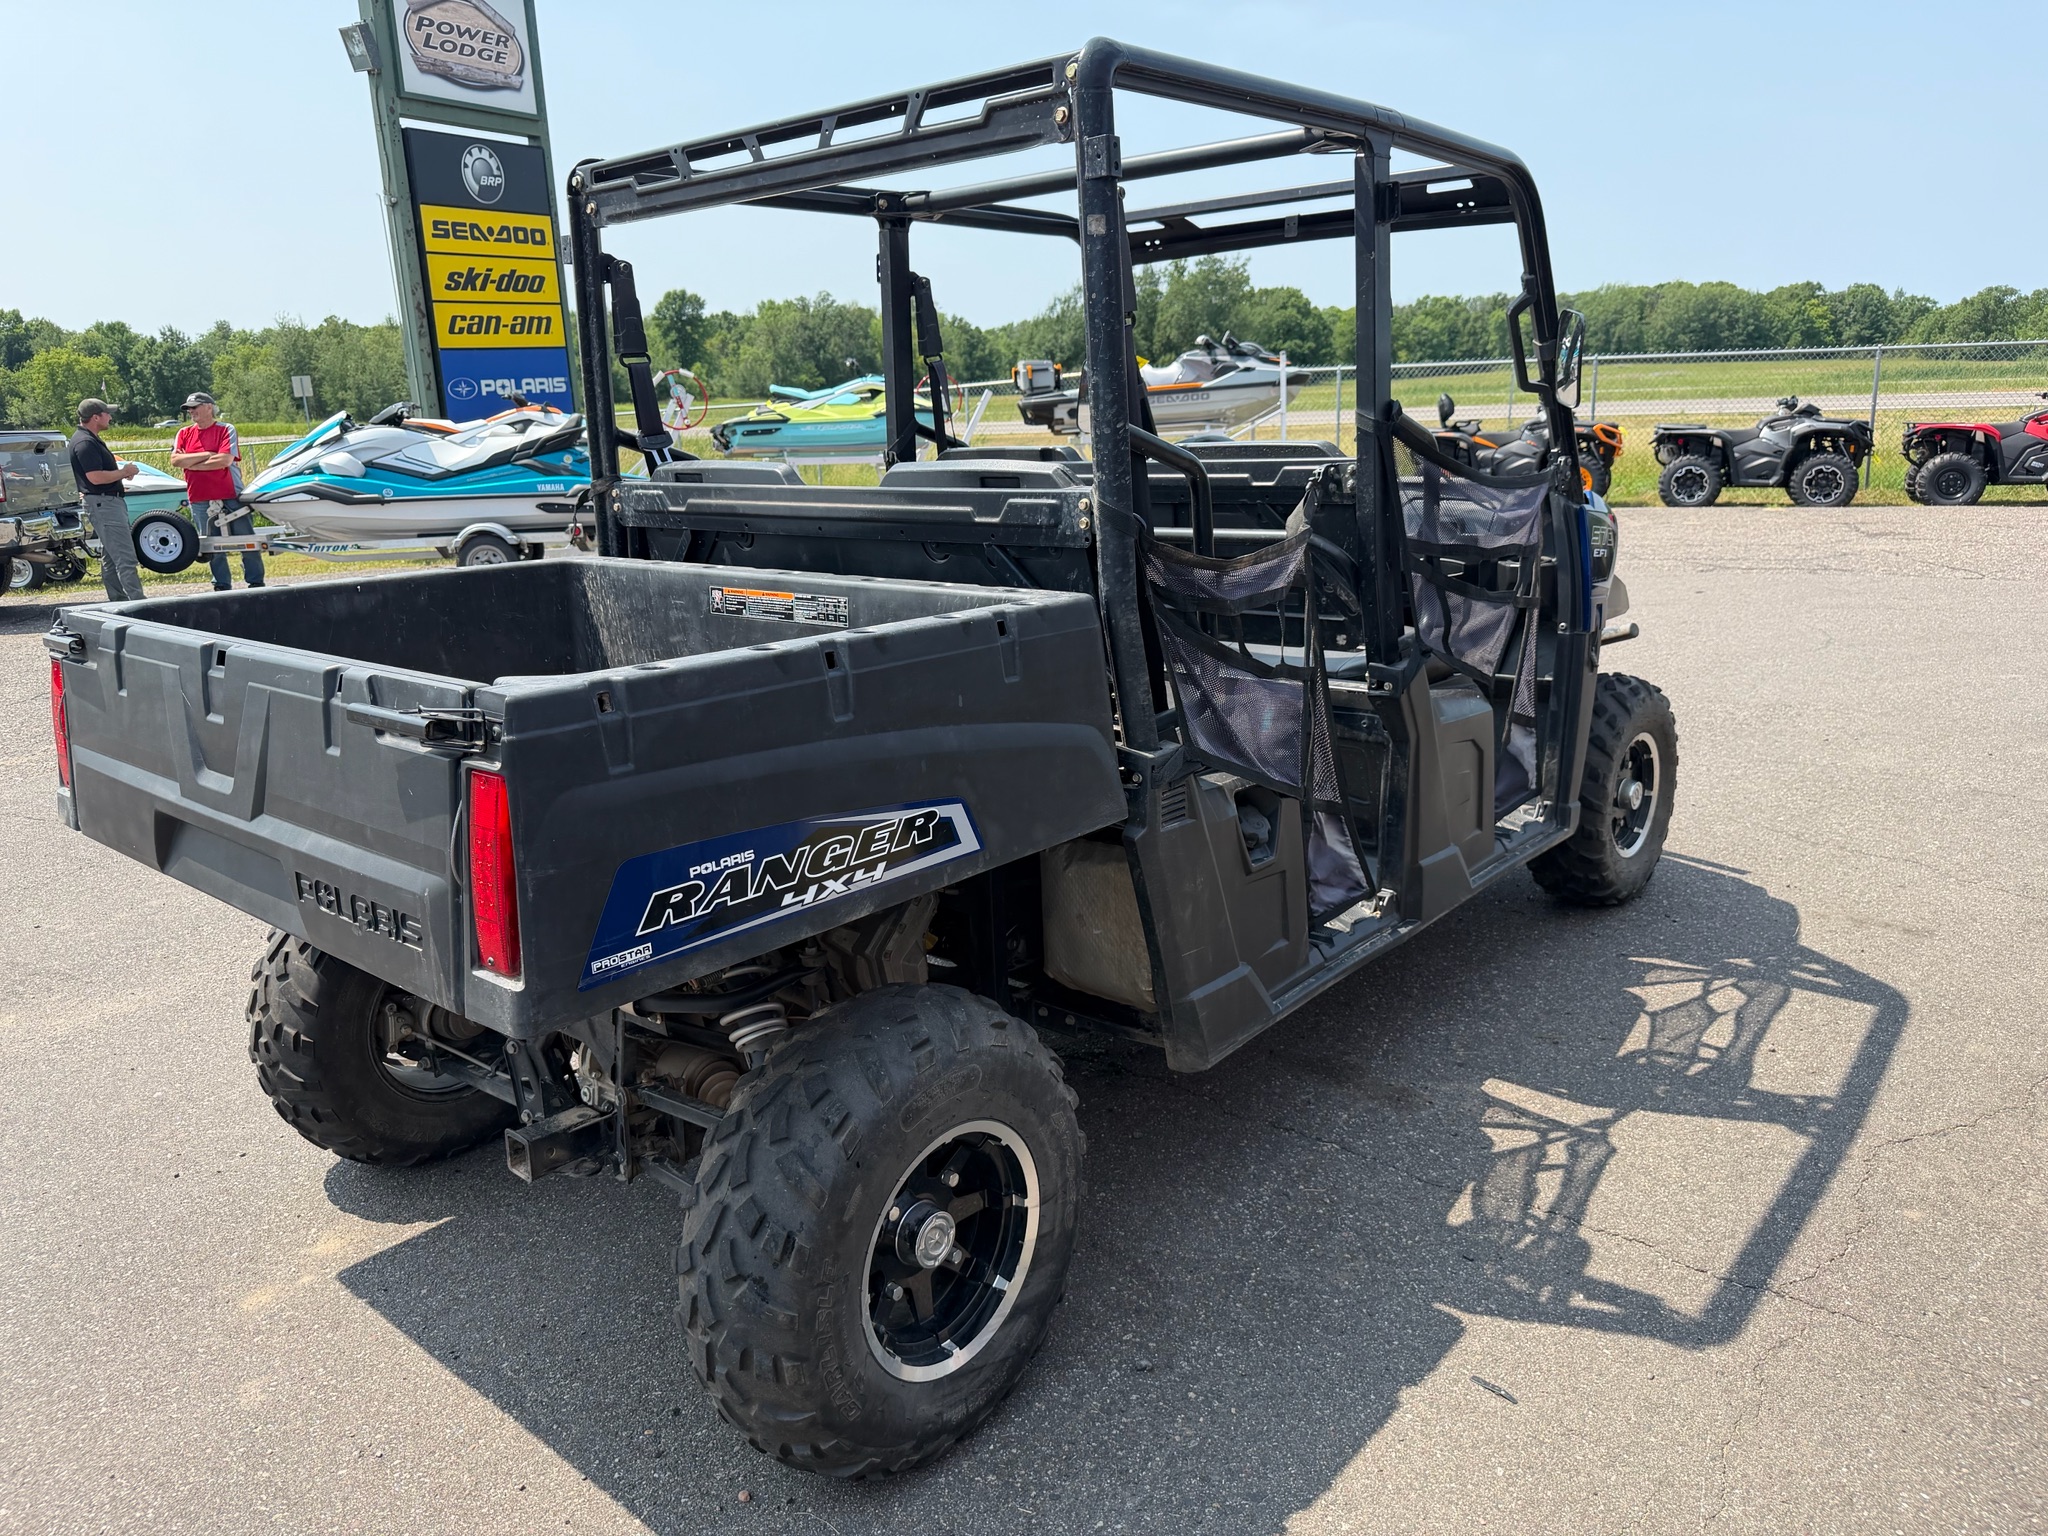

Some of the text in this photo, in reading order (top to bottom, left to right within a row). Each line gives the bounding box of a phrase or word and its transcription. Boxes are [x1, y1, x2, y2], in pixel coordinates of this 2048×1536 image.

[415, 15, 510, 49] POWER
[422, 32, 508, 65] LODGE
[480, 175, 502, 187] BRP
[444, 267, 546, 293] ski-doo
[448, 314, 552, 335] can-am
[480, 377, 567, 396] POLARIS
[536, 483, 565, 492] YAMAHA
[1593, 548, 1607, 558] EFI
[635, 808, 940, 937] RANGER
[689, 849, 755, 878] POLARIS
[294, 871, 423, 951] POLARIS
[592, 944, 652, 973] PROSTAR
